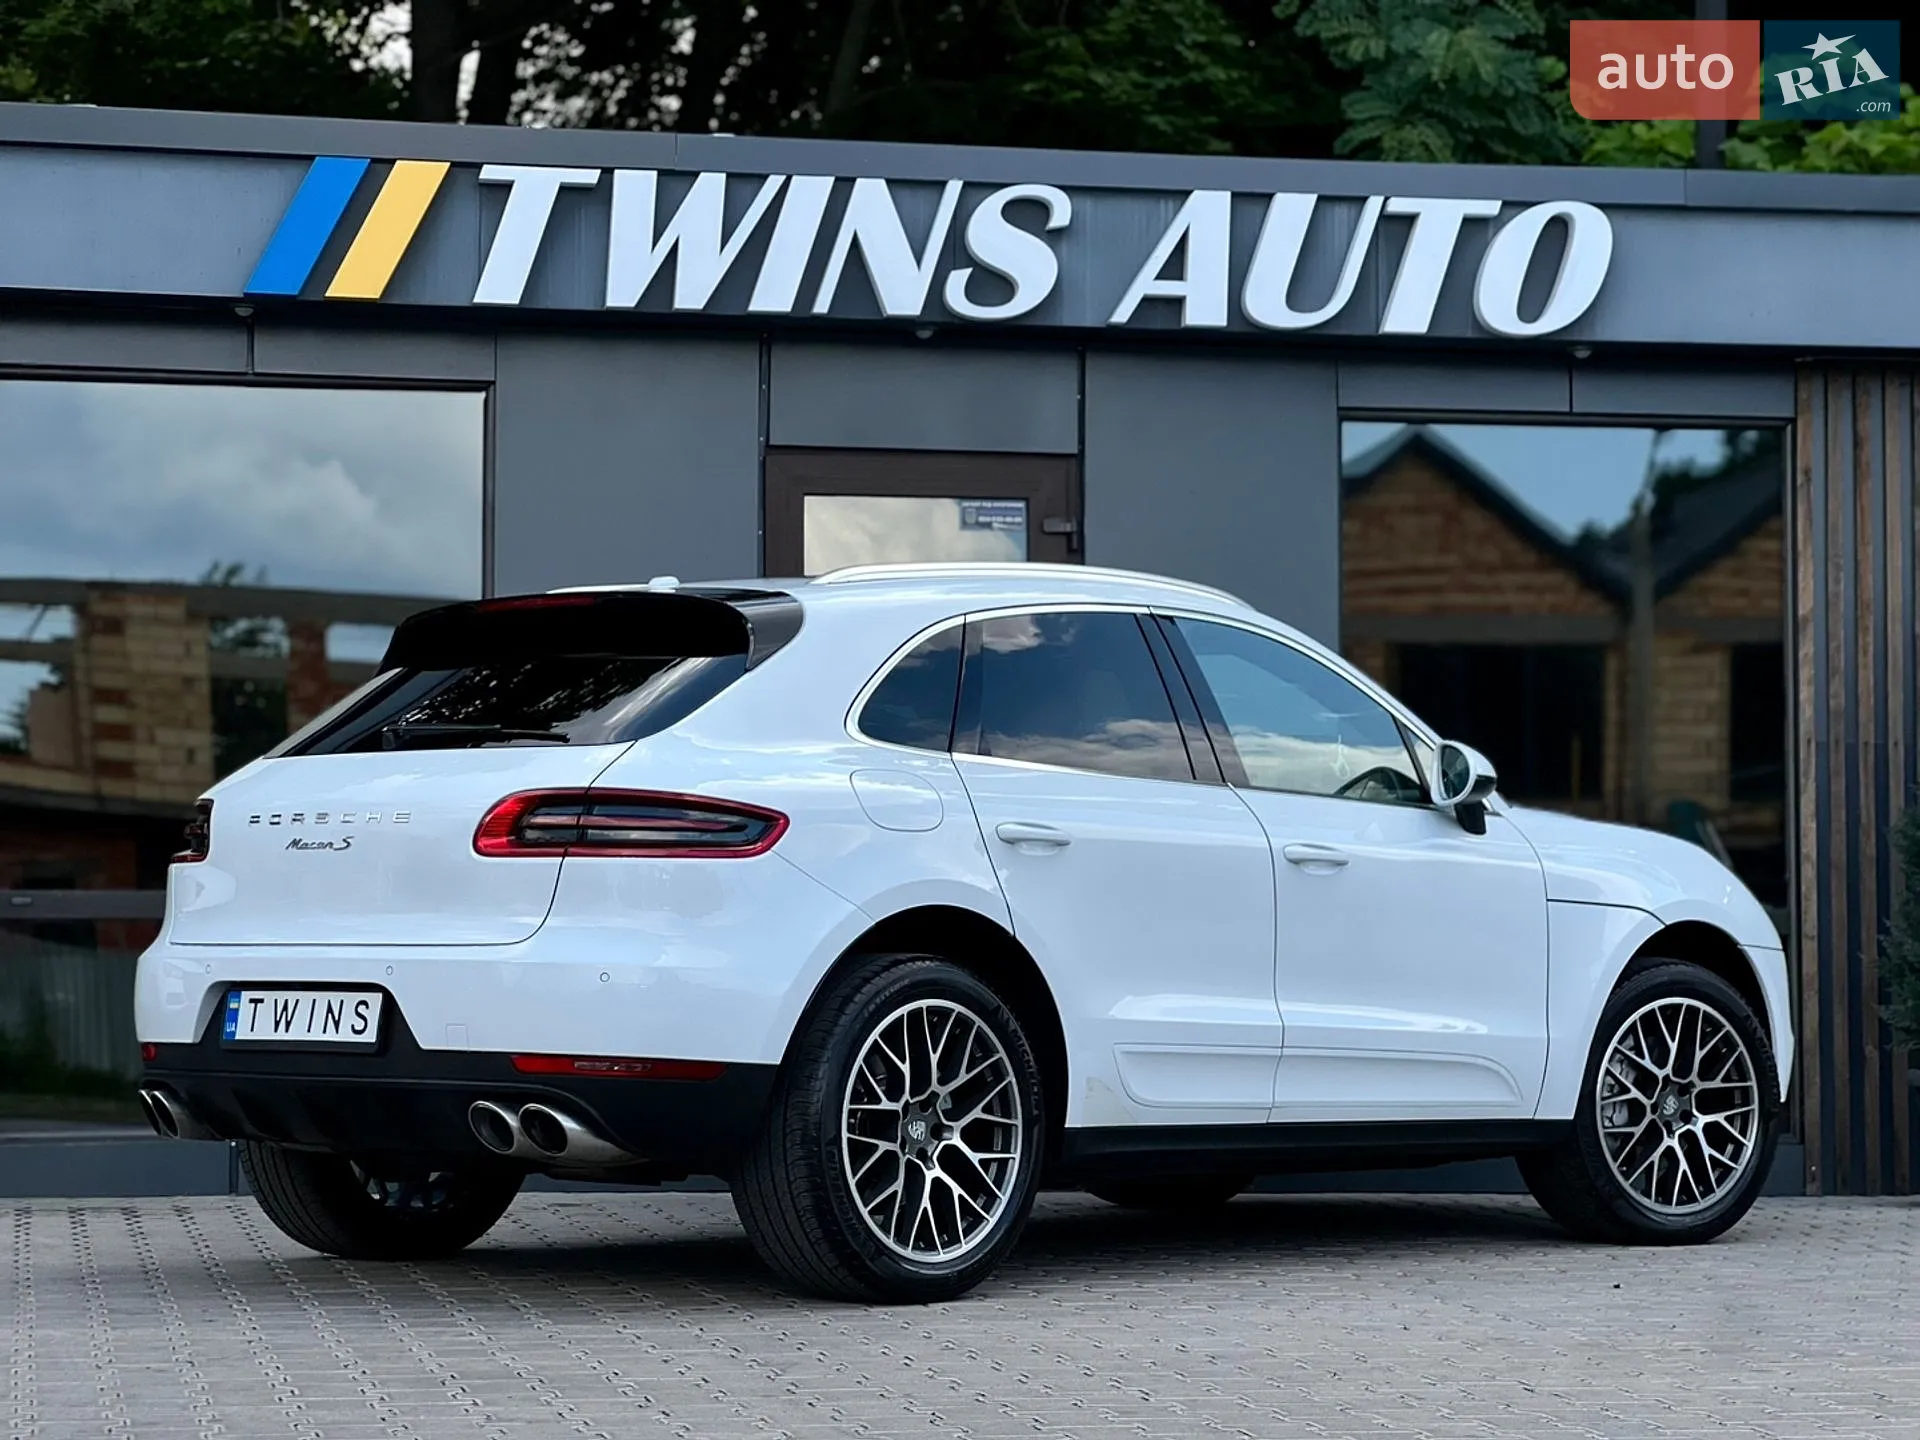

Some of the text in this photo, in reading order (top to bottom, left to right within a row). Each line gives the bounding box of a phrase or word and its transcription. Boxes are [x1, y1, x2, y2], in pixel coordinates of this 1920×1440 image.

[472, 163, 1615, 338] TWINS AUTO
[249, 811, 411, 826] PORSCHE
[285, 836, 355, 851] Macan S
[248, 998, 370, 1035] TWINS
[225, 1021, 236, 1033] UA
